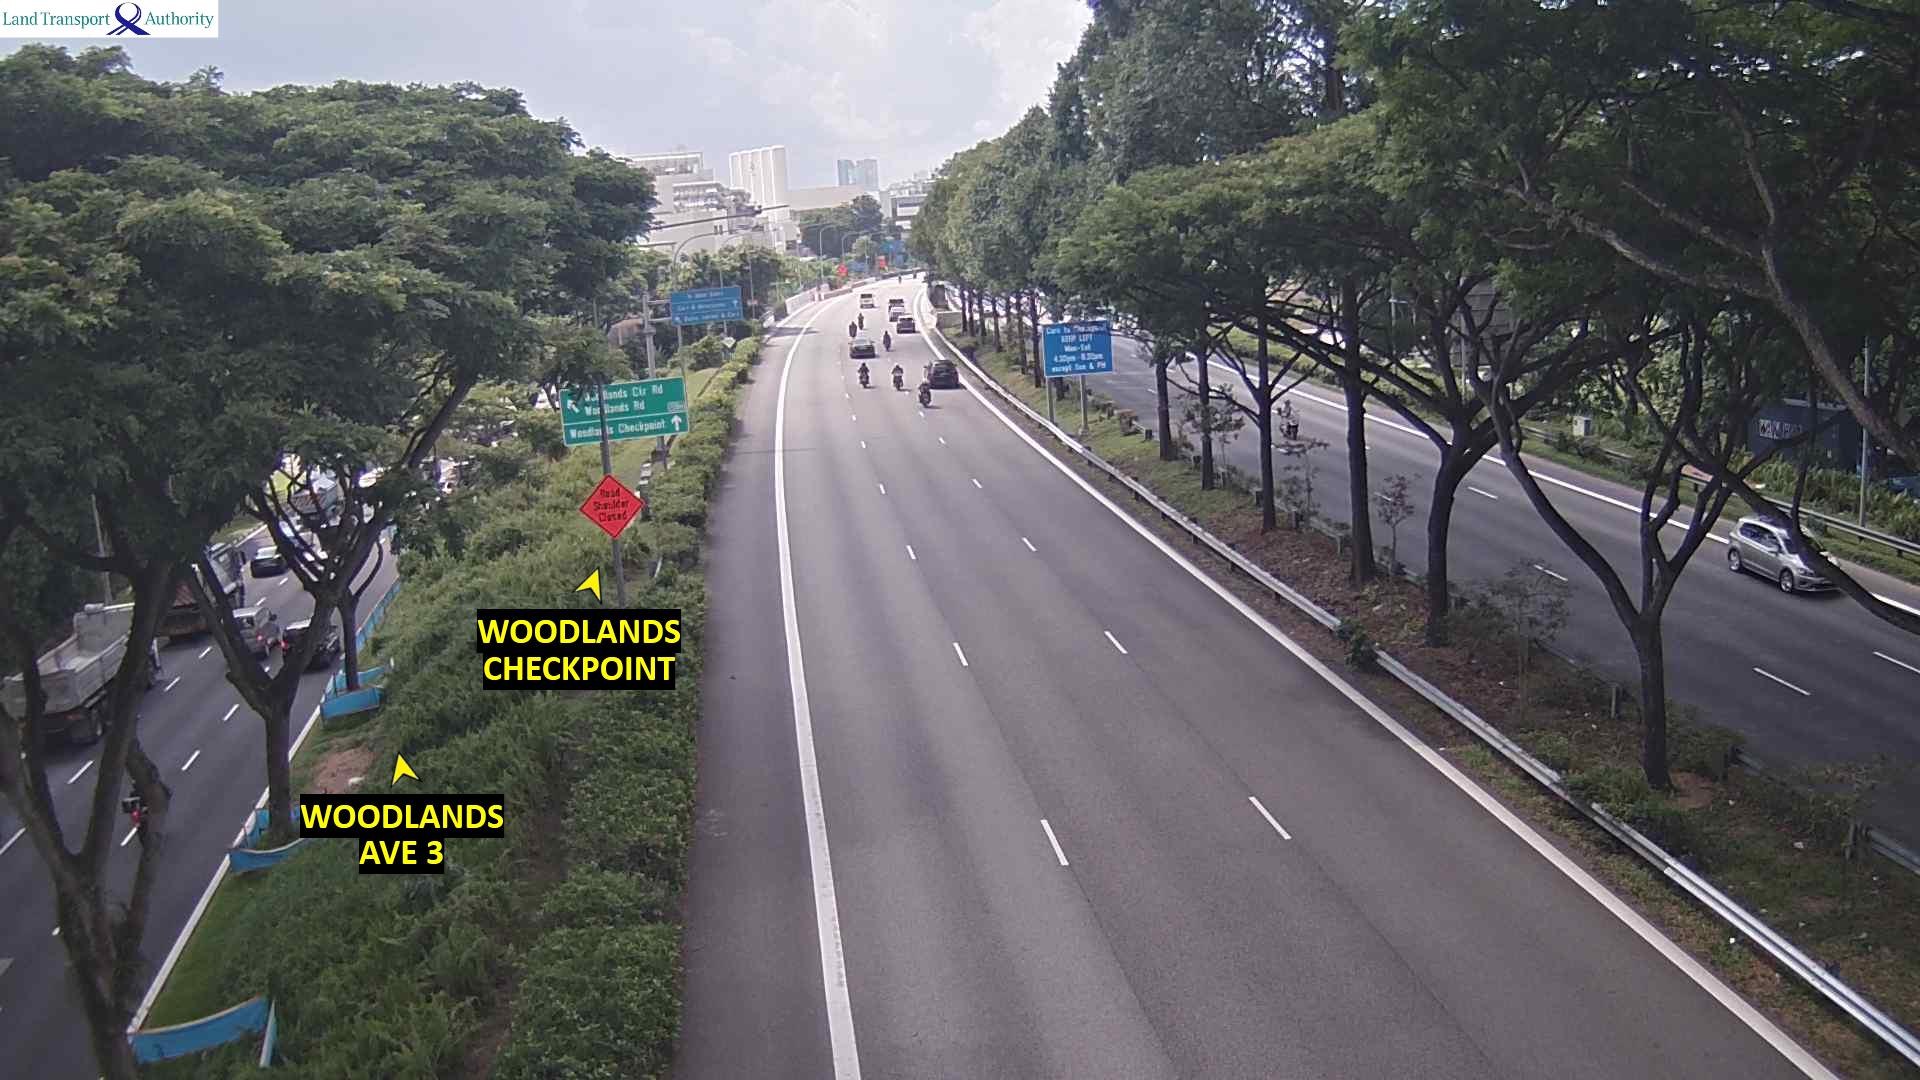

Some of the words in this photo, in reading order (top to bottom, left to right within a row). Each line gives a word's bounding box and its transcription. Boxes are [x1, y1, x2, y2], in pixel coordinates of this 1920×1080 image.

[651, 384, 664, 394] Rd
[633, 400, 646, 410] Rd
[618, 419, 665, 434] Checkpoint
[599, 487, 621, 497] Road
[593, 500, 629, 511] Shoulder
[599, 510, 628, 522] Closed
